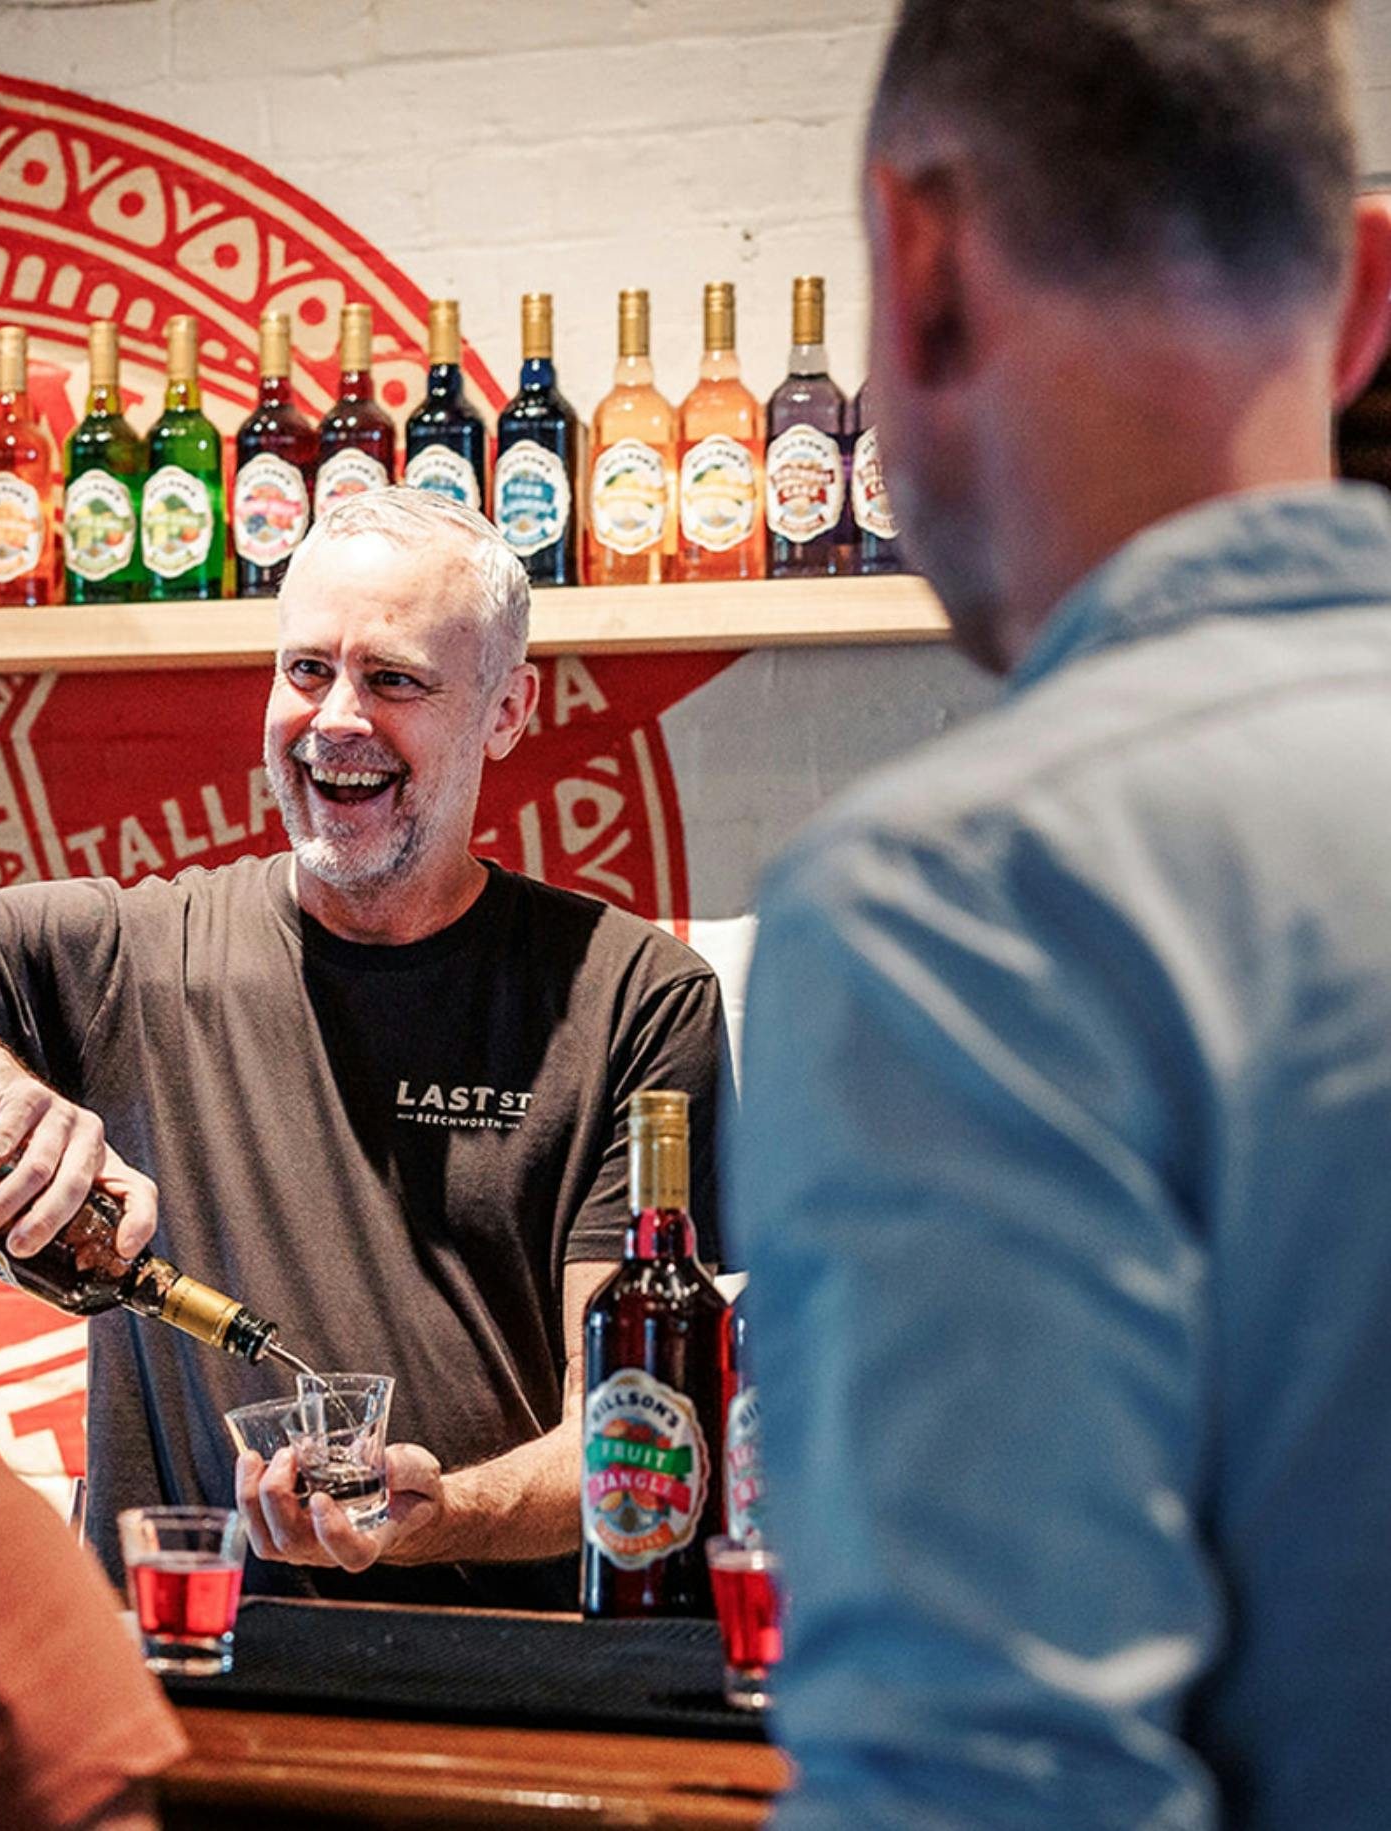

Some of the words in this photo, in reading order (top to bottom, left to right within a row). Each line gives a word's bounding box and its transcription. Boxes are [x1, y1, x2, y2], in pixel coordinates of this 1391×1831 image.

[397, 1080, 495, 1112] LAST
[498, 1091, 532, 1110] ST
[416, 1113, 502, 1129] BEECHWORTH
